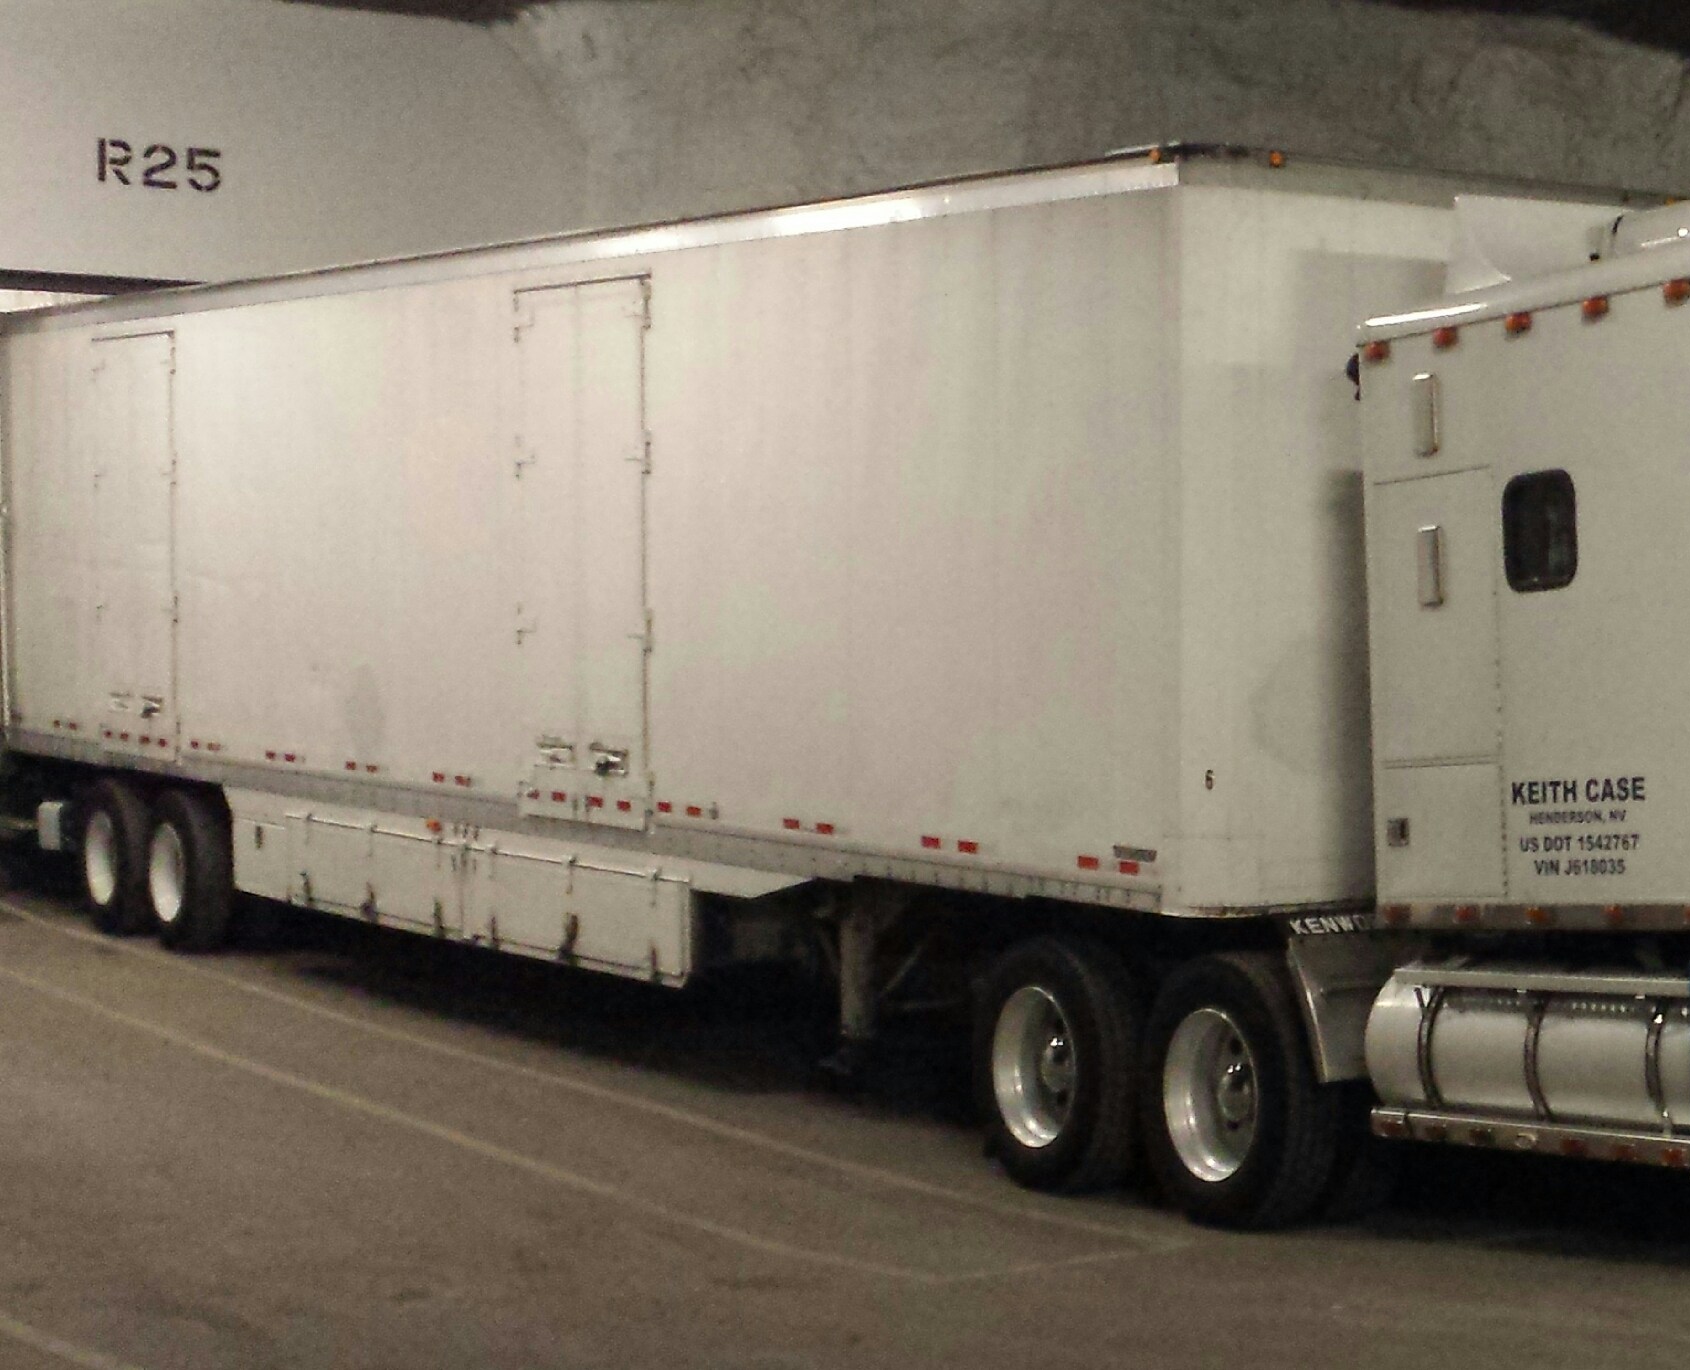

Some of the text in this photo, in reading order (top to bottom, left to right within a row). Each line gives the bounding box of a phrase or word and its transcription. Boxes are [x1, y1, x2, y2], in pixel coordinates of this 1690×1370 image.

[97, 137, 221, 191] R25
[1511, 776, 1646, 805] KEITH CASE
[1608, 809, 1627, 822] NV
[1519, 833, 1639, 852] US DOT 1542767
[1533, 859, 1560, 875] VIN
